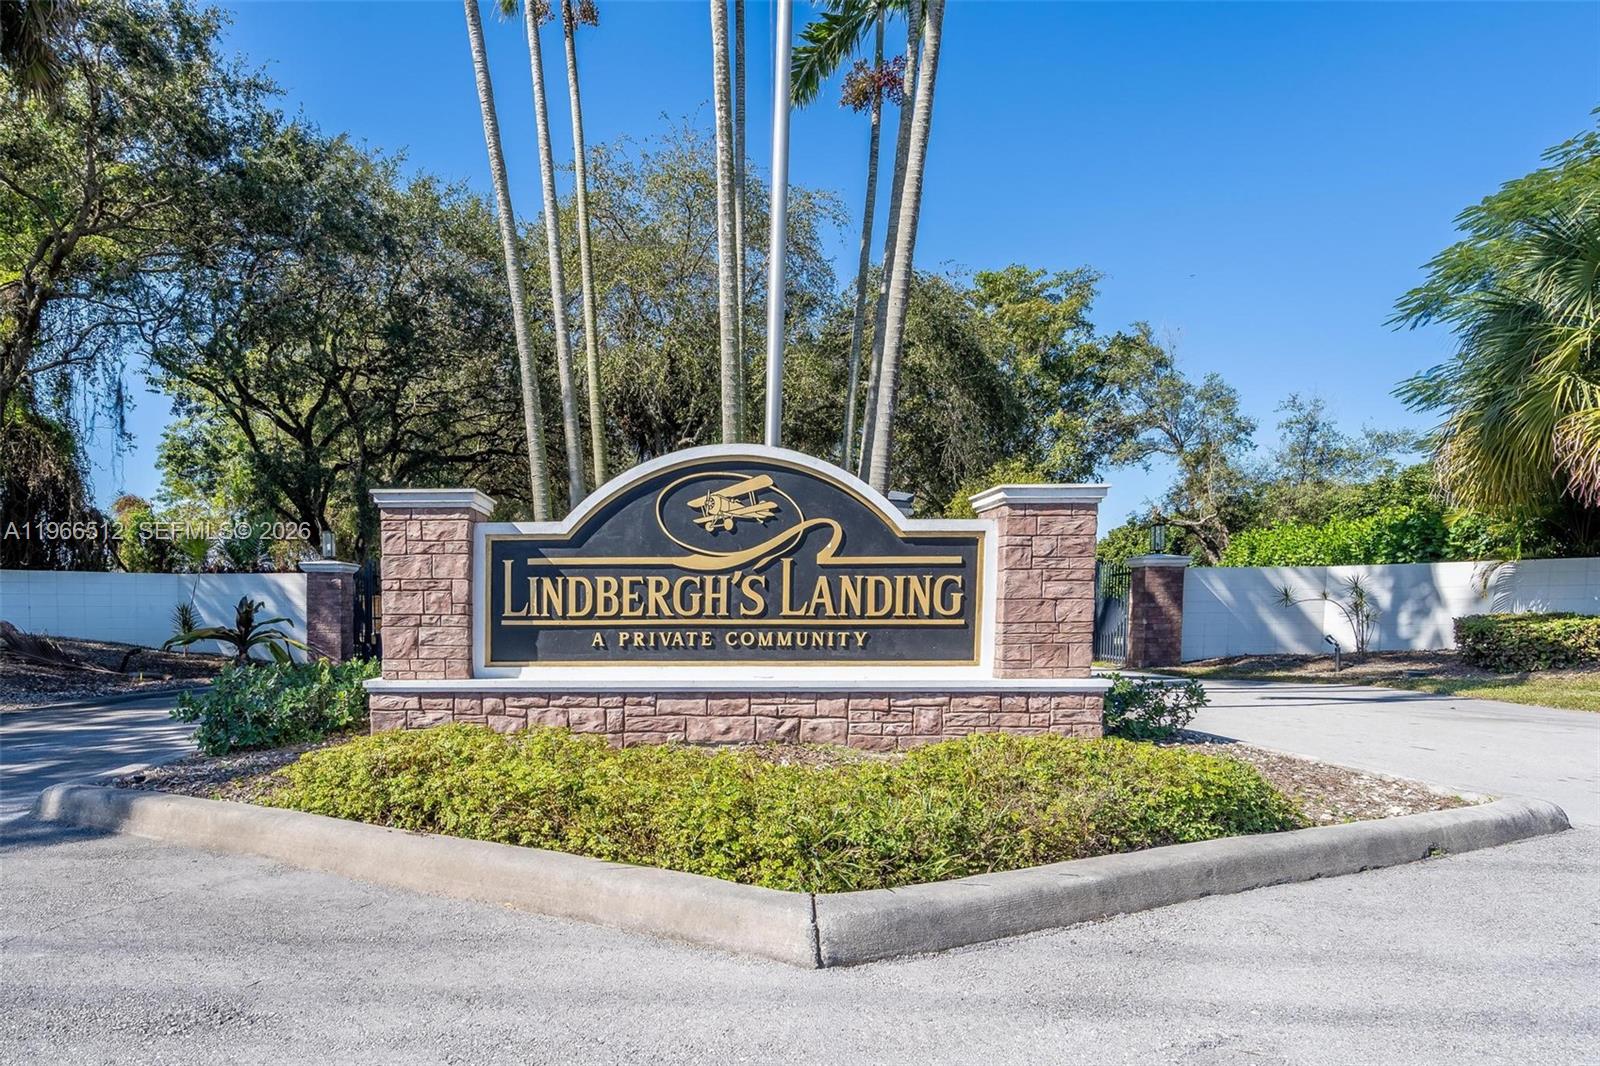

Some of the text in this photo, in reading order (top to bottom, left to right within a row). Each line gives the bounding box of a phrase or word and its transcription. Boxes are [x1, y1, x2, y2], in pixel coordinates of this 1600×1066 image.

[502, 558, 964, 617] LINDBERGH'S LANDING
[592, 631, 867, 647] A PRIVATE COMMUNITY
